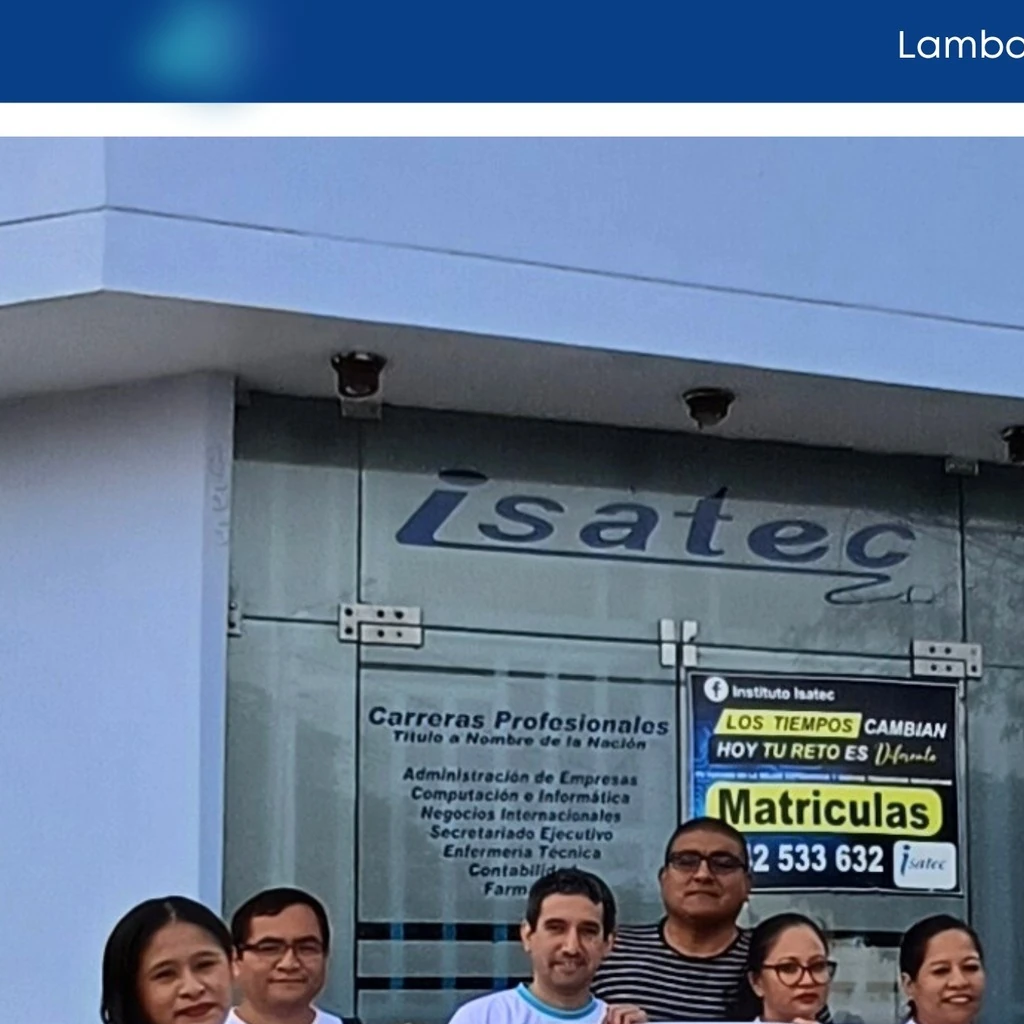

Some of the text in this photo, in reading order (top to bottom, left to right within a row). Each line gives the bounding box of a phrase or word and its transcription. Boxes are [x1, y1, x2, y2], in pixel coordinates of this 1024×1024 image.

[396, 469, 917, 568] isatec
[732, 684, 791, 700] Instituto
[793, 686, 835, 701] Isatec
[368, 705, 670, 736] Carreras Profesionales
[726, 714, 947, 738] LOS TIEMPOS CAMBIAN
[449, 733, 460, 744] a
[466, 732, 534, 746] Nombre
[540, 735, 561, 747] de
[565, 735, 582, 748] la
[716, 741, 759, 758] HOY
[764, 742, 787, 759] TU
[790, 743, 841, 760] RETO
[844, 744, 869, 761] ES
[403, 766, 638, 789] Administración de Empresas
[411, 785, 519, 805] Computación
[523, 791, 534, 803] e
[420, 805, 621, 824] Negocios Internacionales
[430, 825, 613, 843] Secretariado Ejecutivo
[747, 844, 947, 877] 2 533 632 isatec
[484, 881, 528, 896] Farm
